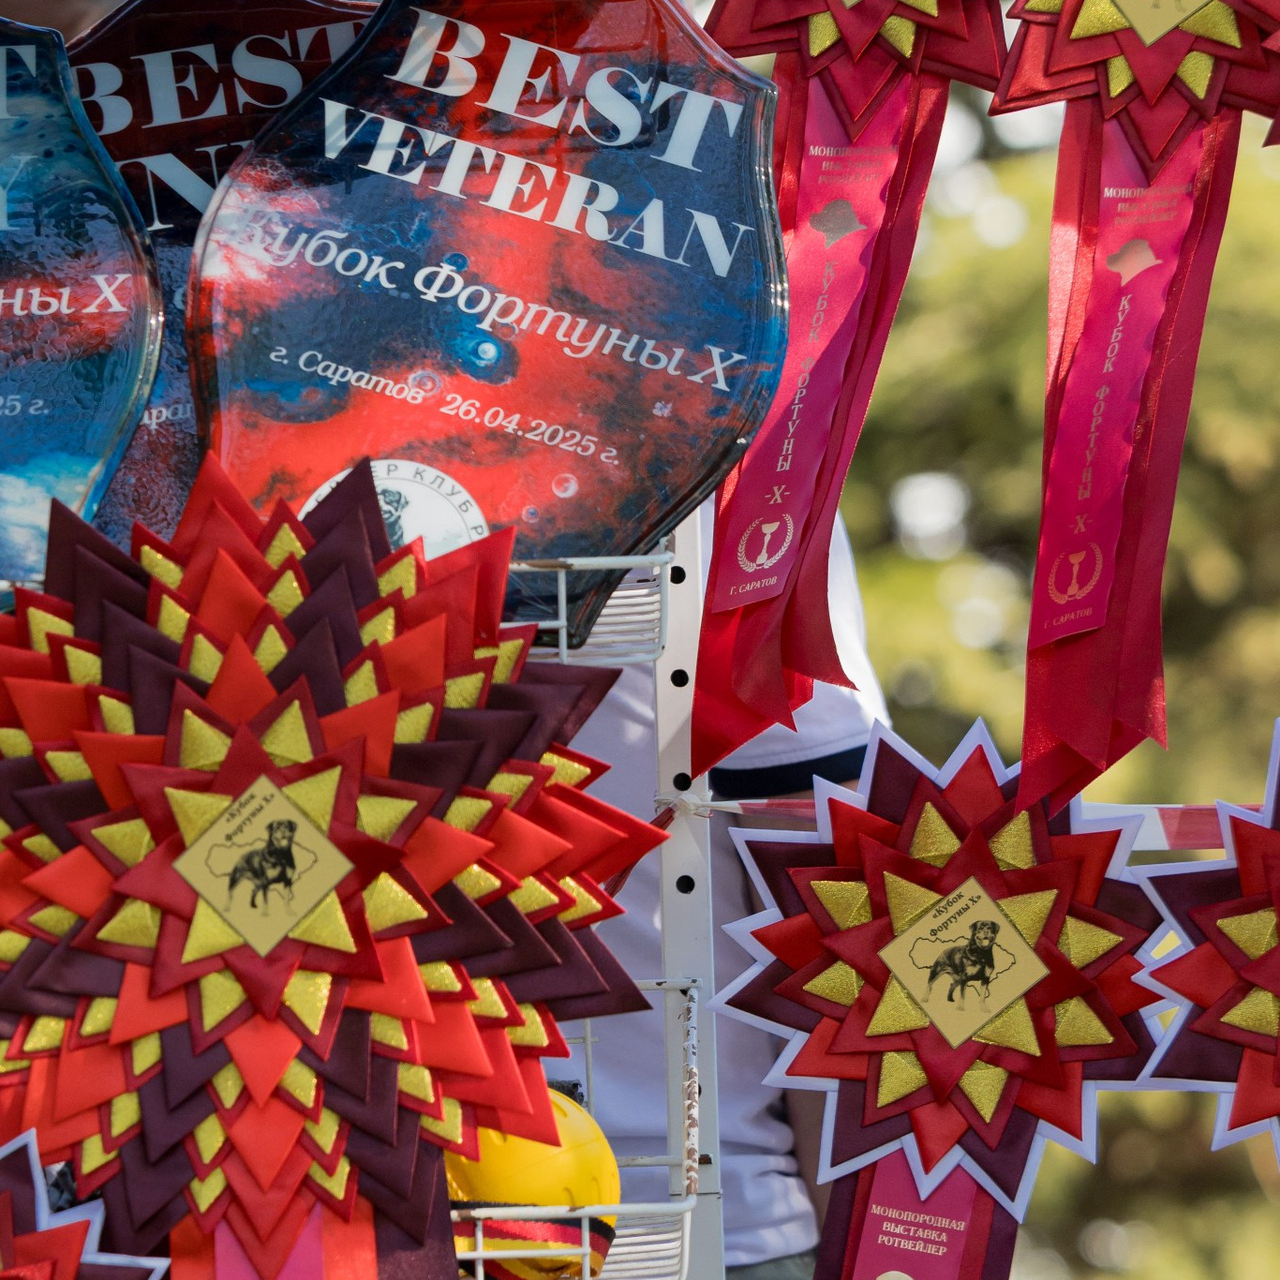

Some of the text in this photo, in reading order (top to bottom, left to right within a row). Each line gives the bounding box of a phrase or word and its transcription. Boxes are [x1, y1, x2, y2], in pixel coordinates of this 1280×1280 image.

[384, 7, 745, 173] BEST
[318, 97, 755, 278] VETERAN
[413, 262, 683, 376] Фортуны
[1103, 294, 1133, 373] КУБОК
[298, 349, 426, 406] Саратов
[439, 392, 598, 458] 26.04.2025
[413, 467, 474, 514] КЛУБ
[739, 575, 778, 594] САРАТОВ
[870, 1204, 966, 1231] МОНОПОРОДНАЯ
[877, 1234, 948, 1256] РОТВЕЙЛЕР
[882, 1222, 948, 1242] ВЫСТАВКА
